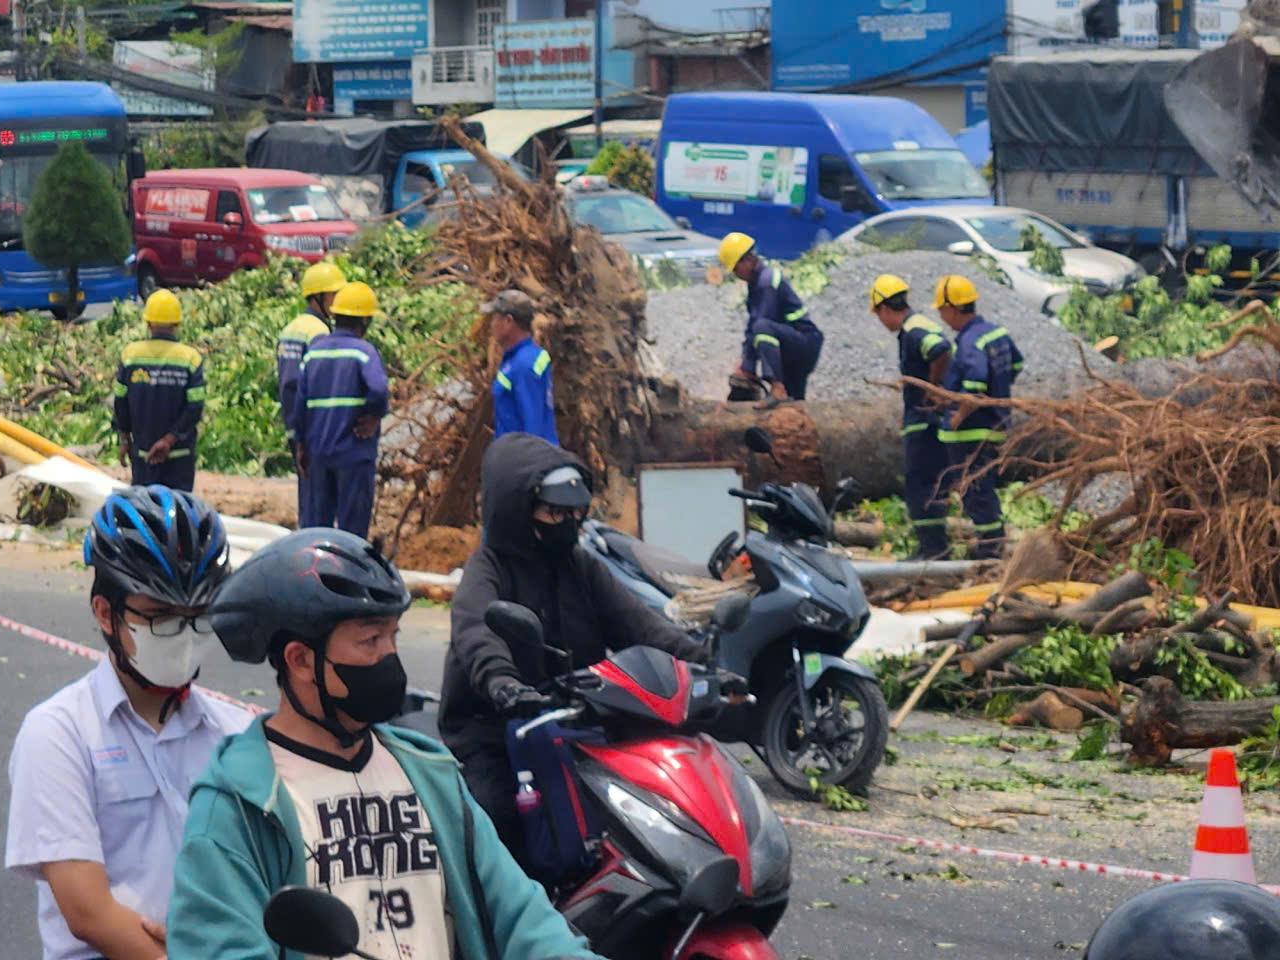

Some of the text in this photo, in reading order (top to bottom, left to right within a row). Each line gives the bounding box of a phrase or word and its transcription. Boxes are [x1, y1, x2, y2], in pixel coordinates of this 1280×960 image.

[316, 793, 421, 839] KING
[315, 832, 438, 884] KONG
[368, 888, 415, 931] 79
